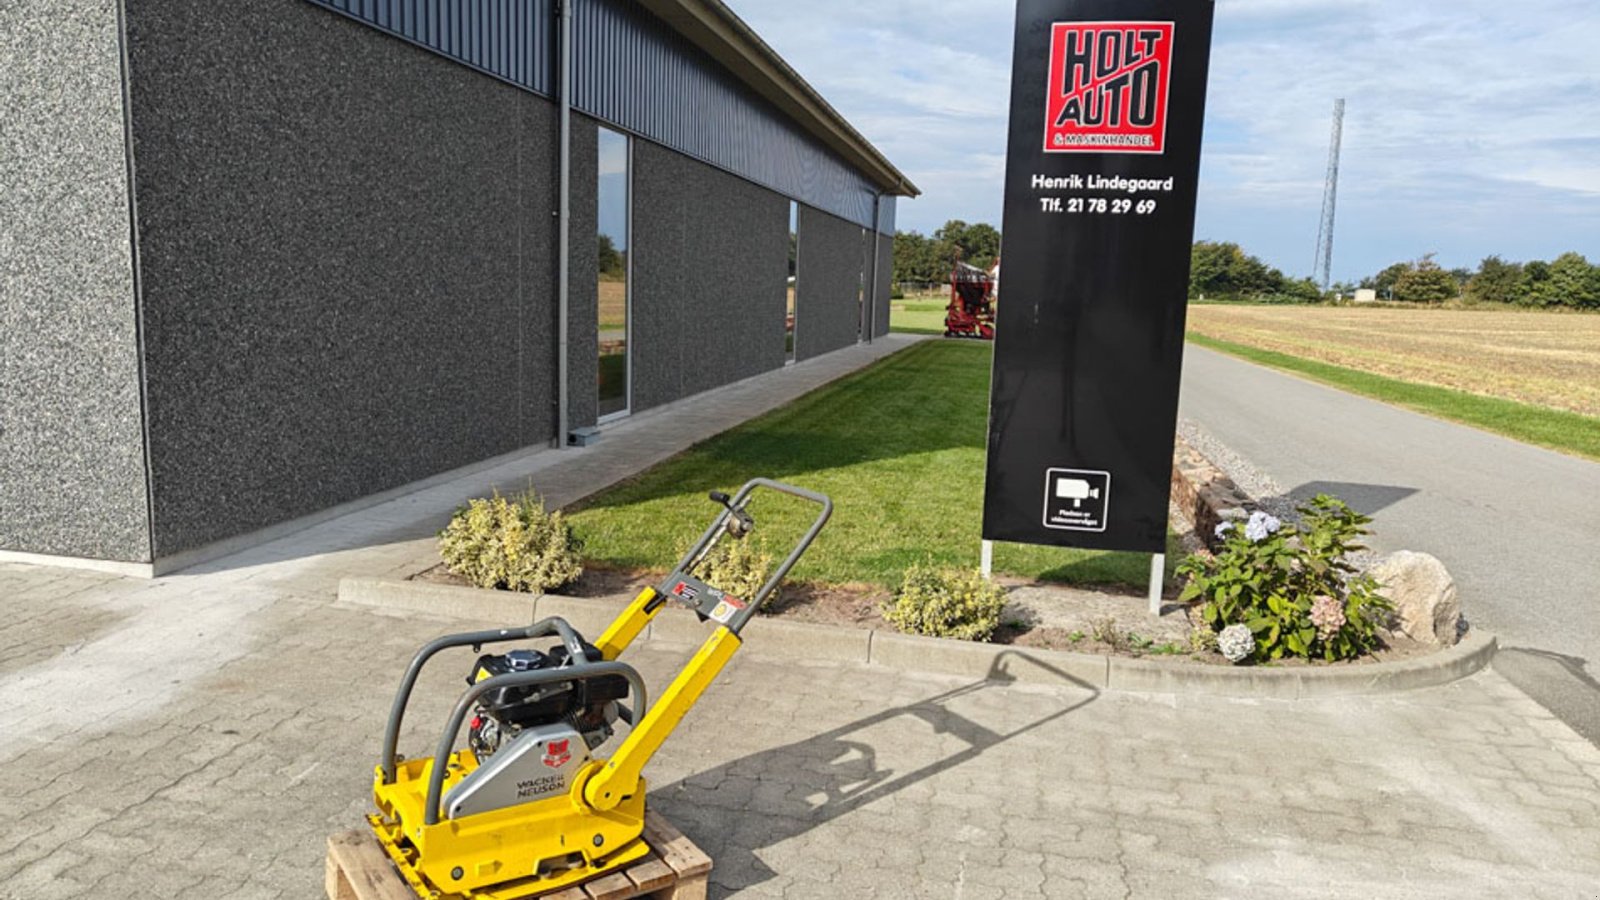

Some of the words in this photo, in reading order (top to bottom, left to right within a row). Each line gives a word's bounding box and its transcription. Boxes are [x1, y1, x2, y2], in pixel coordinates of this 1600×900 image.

[1061, 29, 1163, 97] HOLT
[1055, 60, 1160, 127] AUTO
[1054, 132, 1064, 145] &
[1066, 134, 1155, 146] MASKINHANDEL
[1031, 174, 1084, 190] Henrik
[1087, 175, 1174, 193] Lindegaard
[1040, 198, 1063, 212] Tlf.
[1067, 198, 1084, 212] 21
[1088, 198, 1107, 213] 78
[1111, 199, 1131, 213] 29
[1136, 200, 1156, 214] 69
